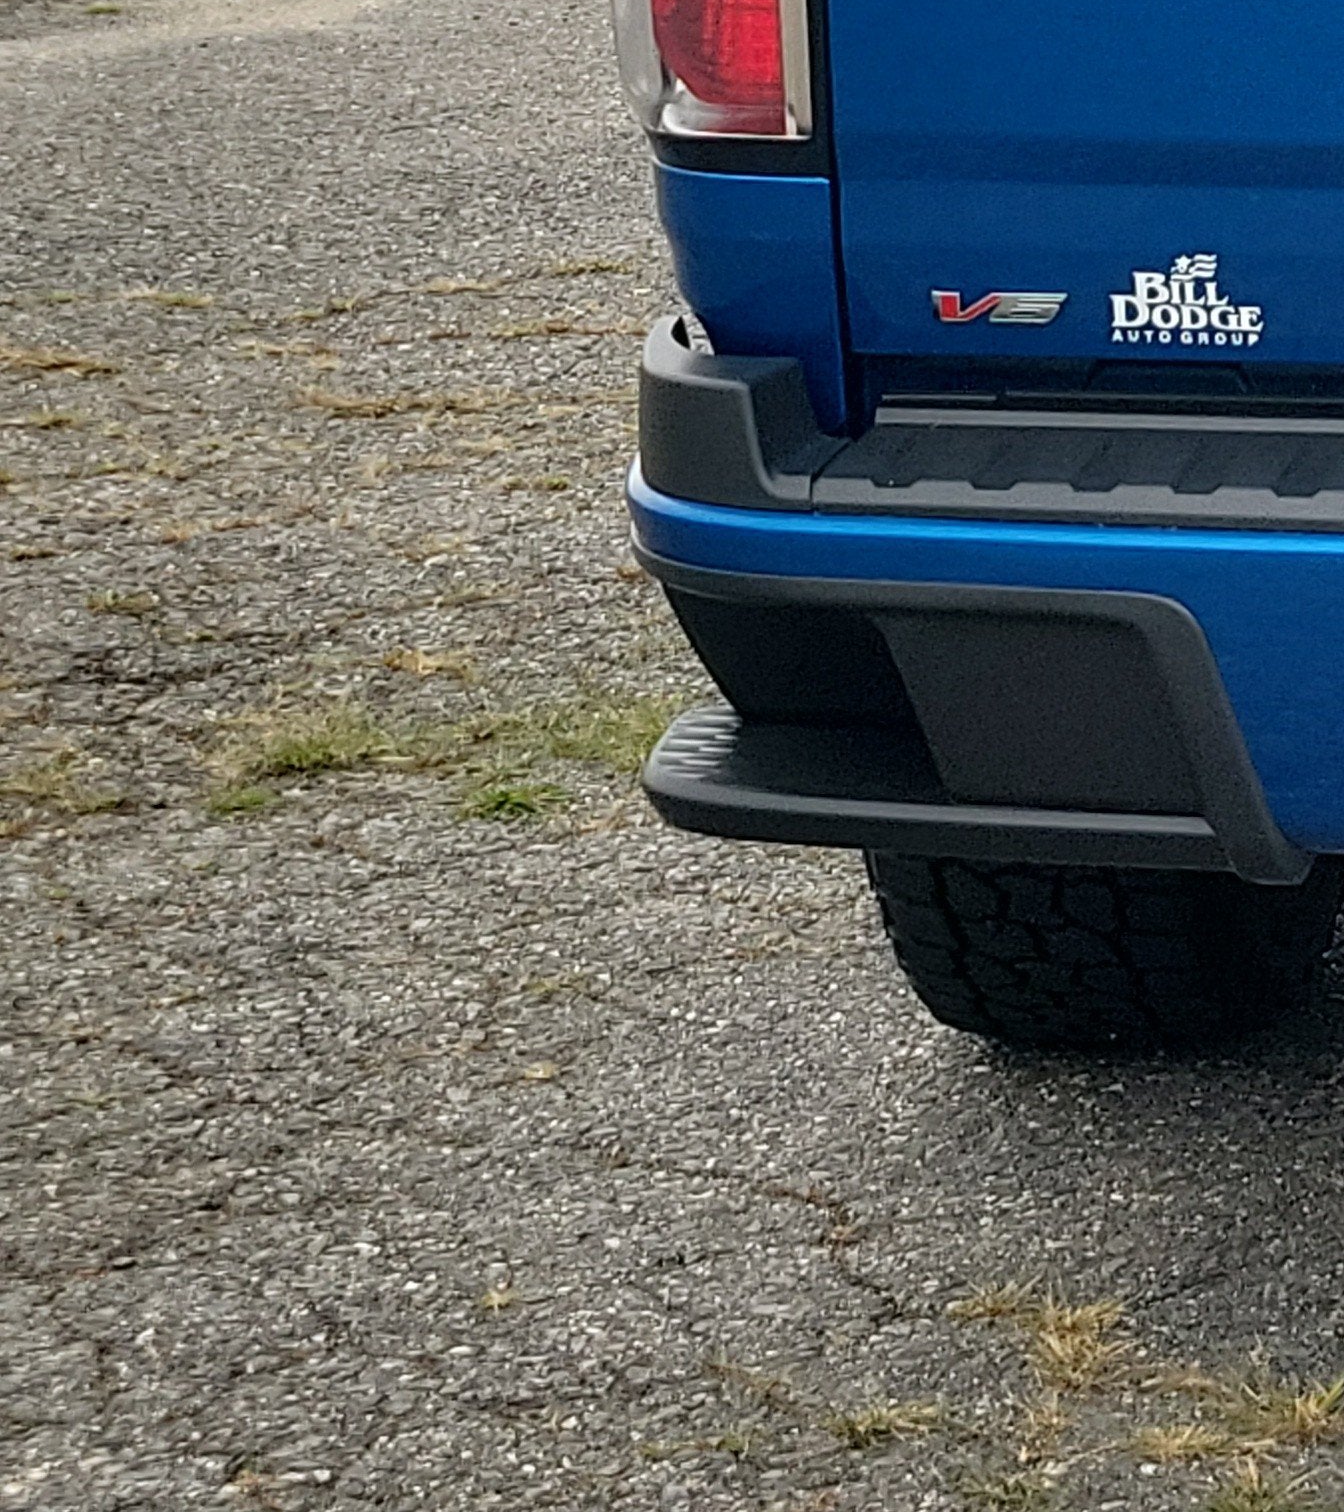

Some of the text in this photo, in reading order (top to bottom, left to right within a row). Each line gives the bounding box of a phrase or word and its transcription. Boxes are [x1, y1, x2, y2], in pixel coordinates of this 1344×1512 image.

[1133, 271, 1229, 306] BILL
[932, 291, 1067, 323] V6
[1111, 295, 1263, 331] DODGE
[1111, 329, 1261, 347] AUTO GROUP
